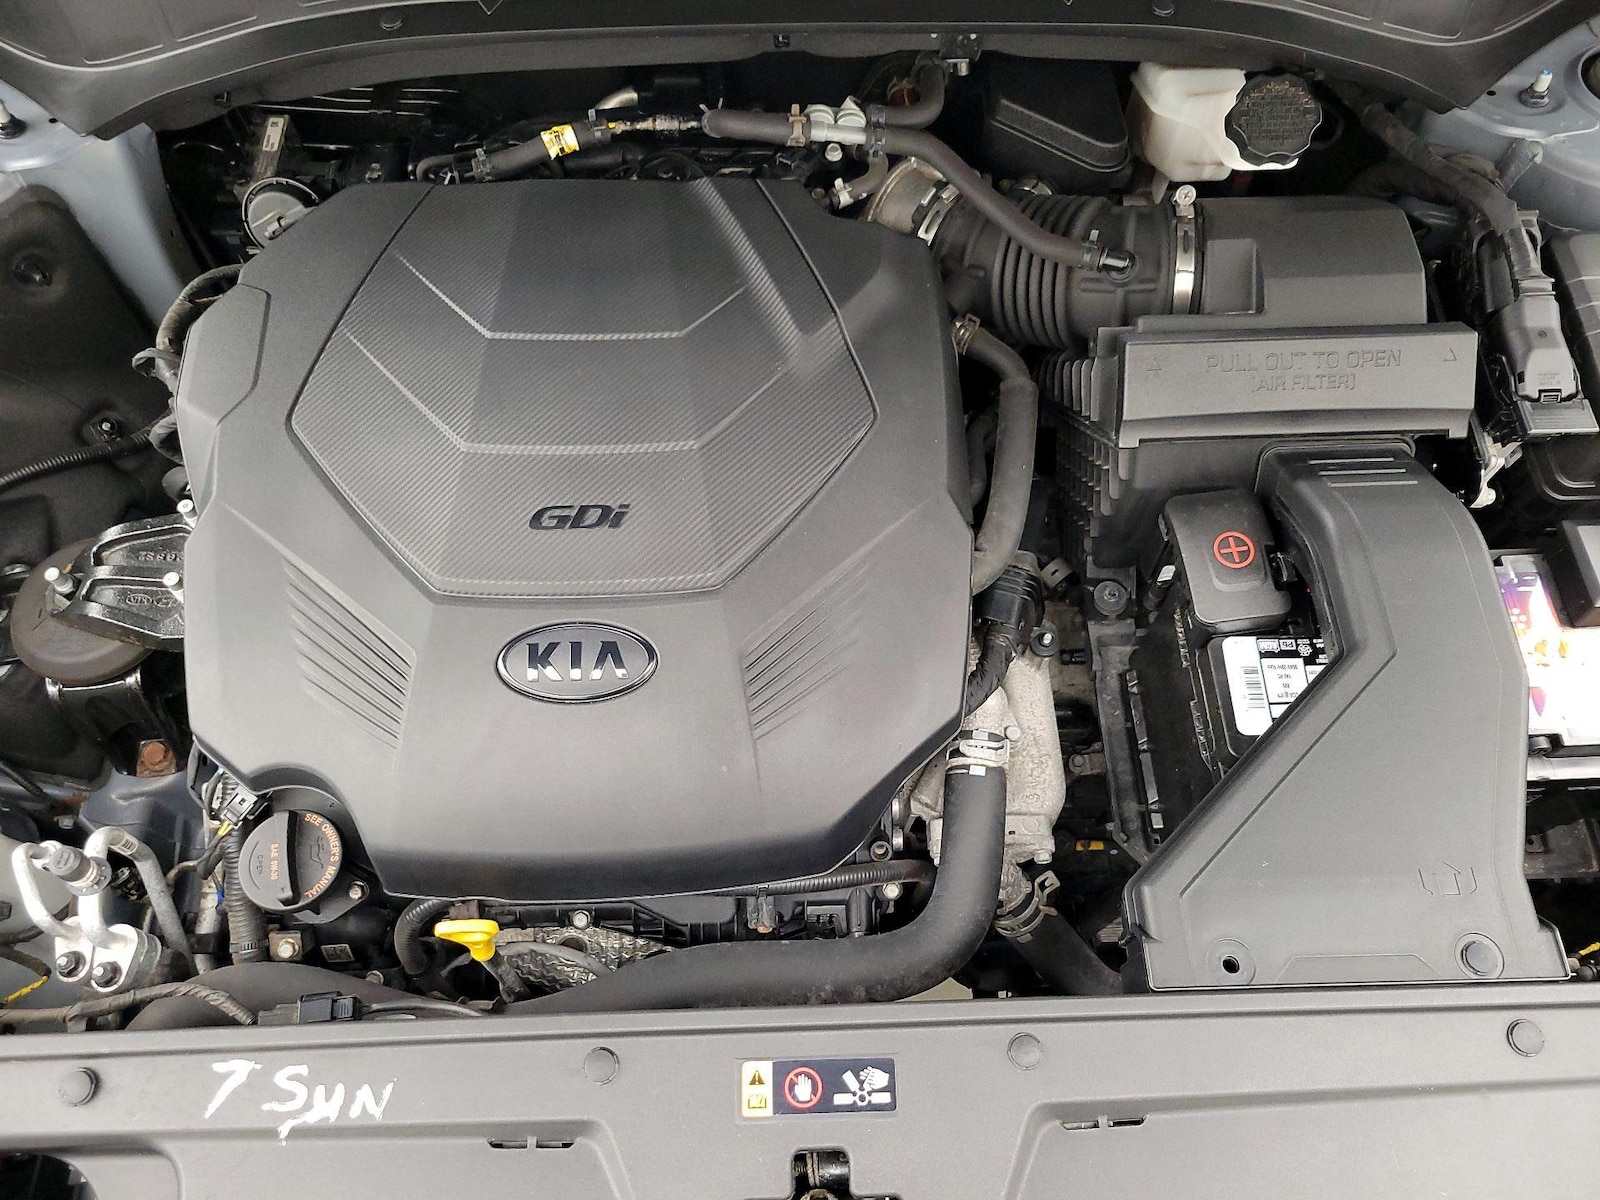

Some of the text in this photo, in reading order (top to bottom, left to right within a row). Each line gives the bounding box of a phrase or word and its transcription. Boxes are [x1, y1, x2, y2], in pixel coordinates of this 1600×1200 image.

[1205, 349, 1402, 373] PULL OUT TO OPEN
[529, 504, 630, 529] GDi
[526, 641, 630, 682] KIA
[271, 843, 279, 858] SAE
[304, 813, 339, 898] SEE OWNER'S MANUAL
